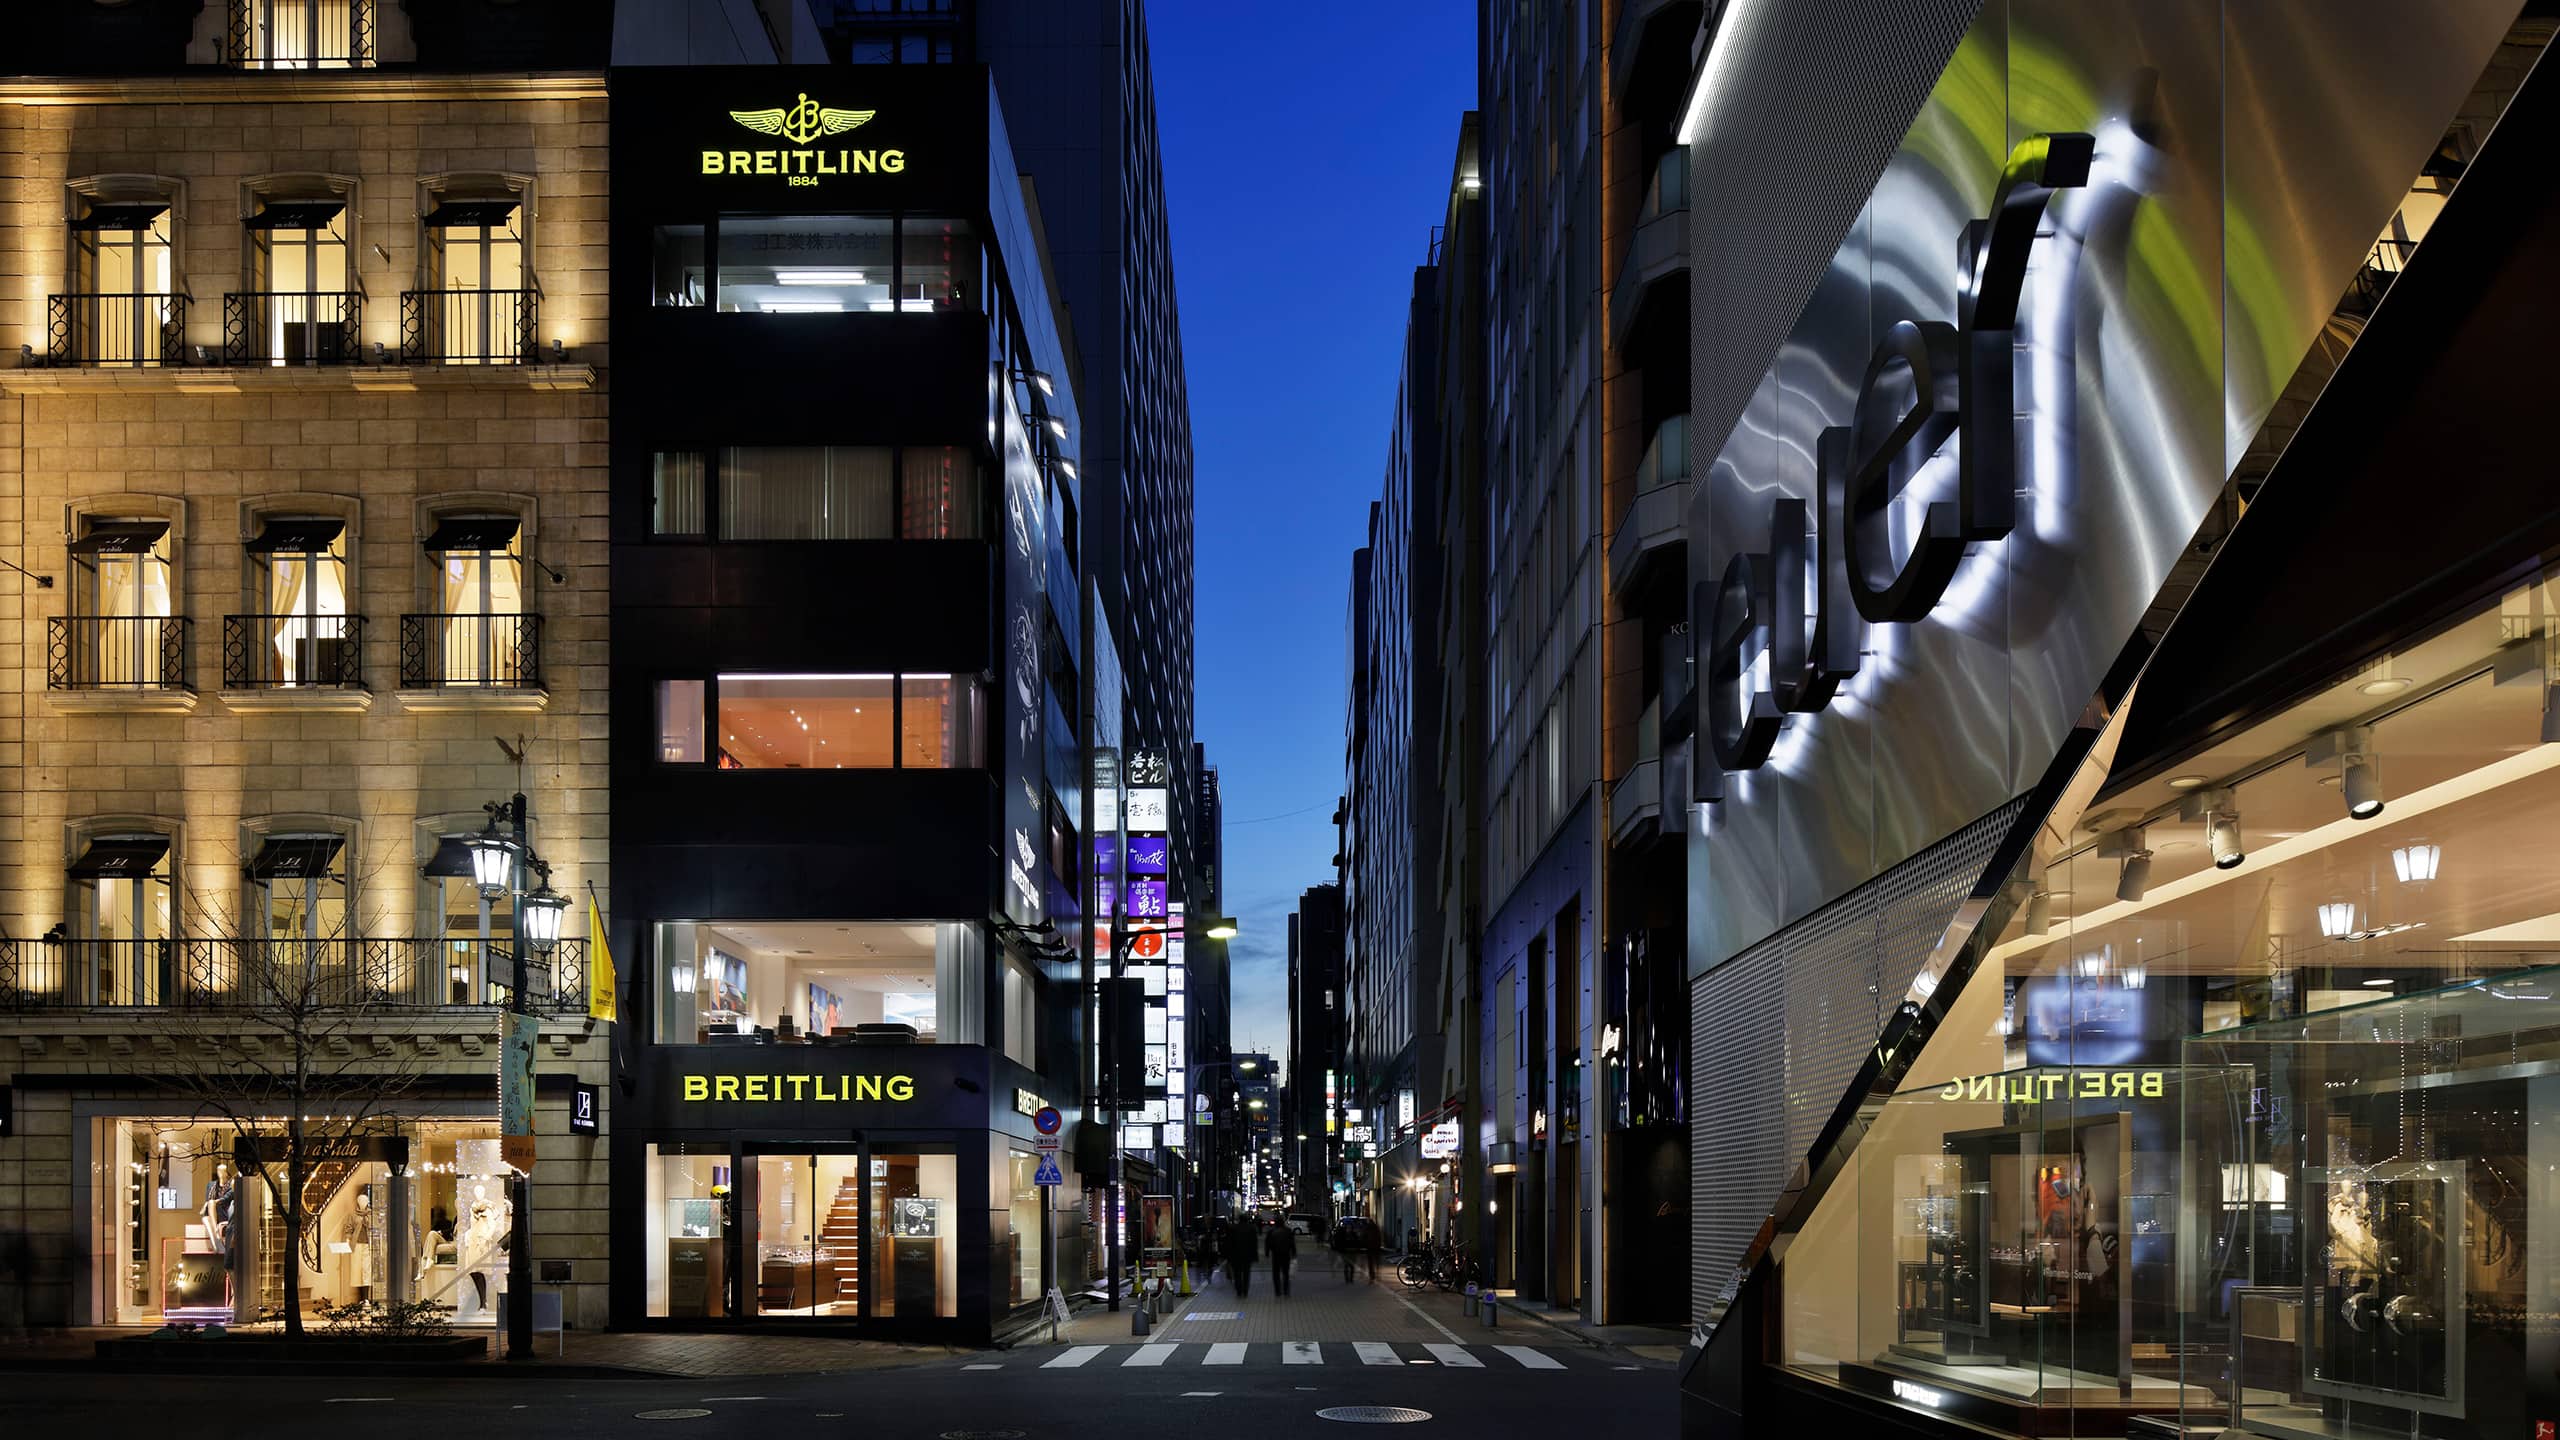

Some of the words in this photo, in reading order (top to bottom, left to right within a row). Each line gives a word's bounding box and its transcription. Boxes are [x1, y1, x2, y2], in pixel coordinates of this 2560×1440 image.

[701, 149, 905, 174] BREITLING
[788, 176, 819, 187] 1884
[1131, 769, 1164, 783] ビル
[682, 1074, 915, 1103] BREITLING
